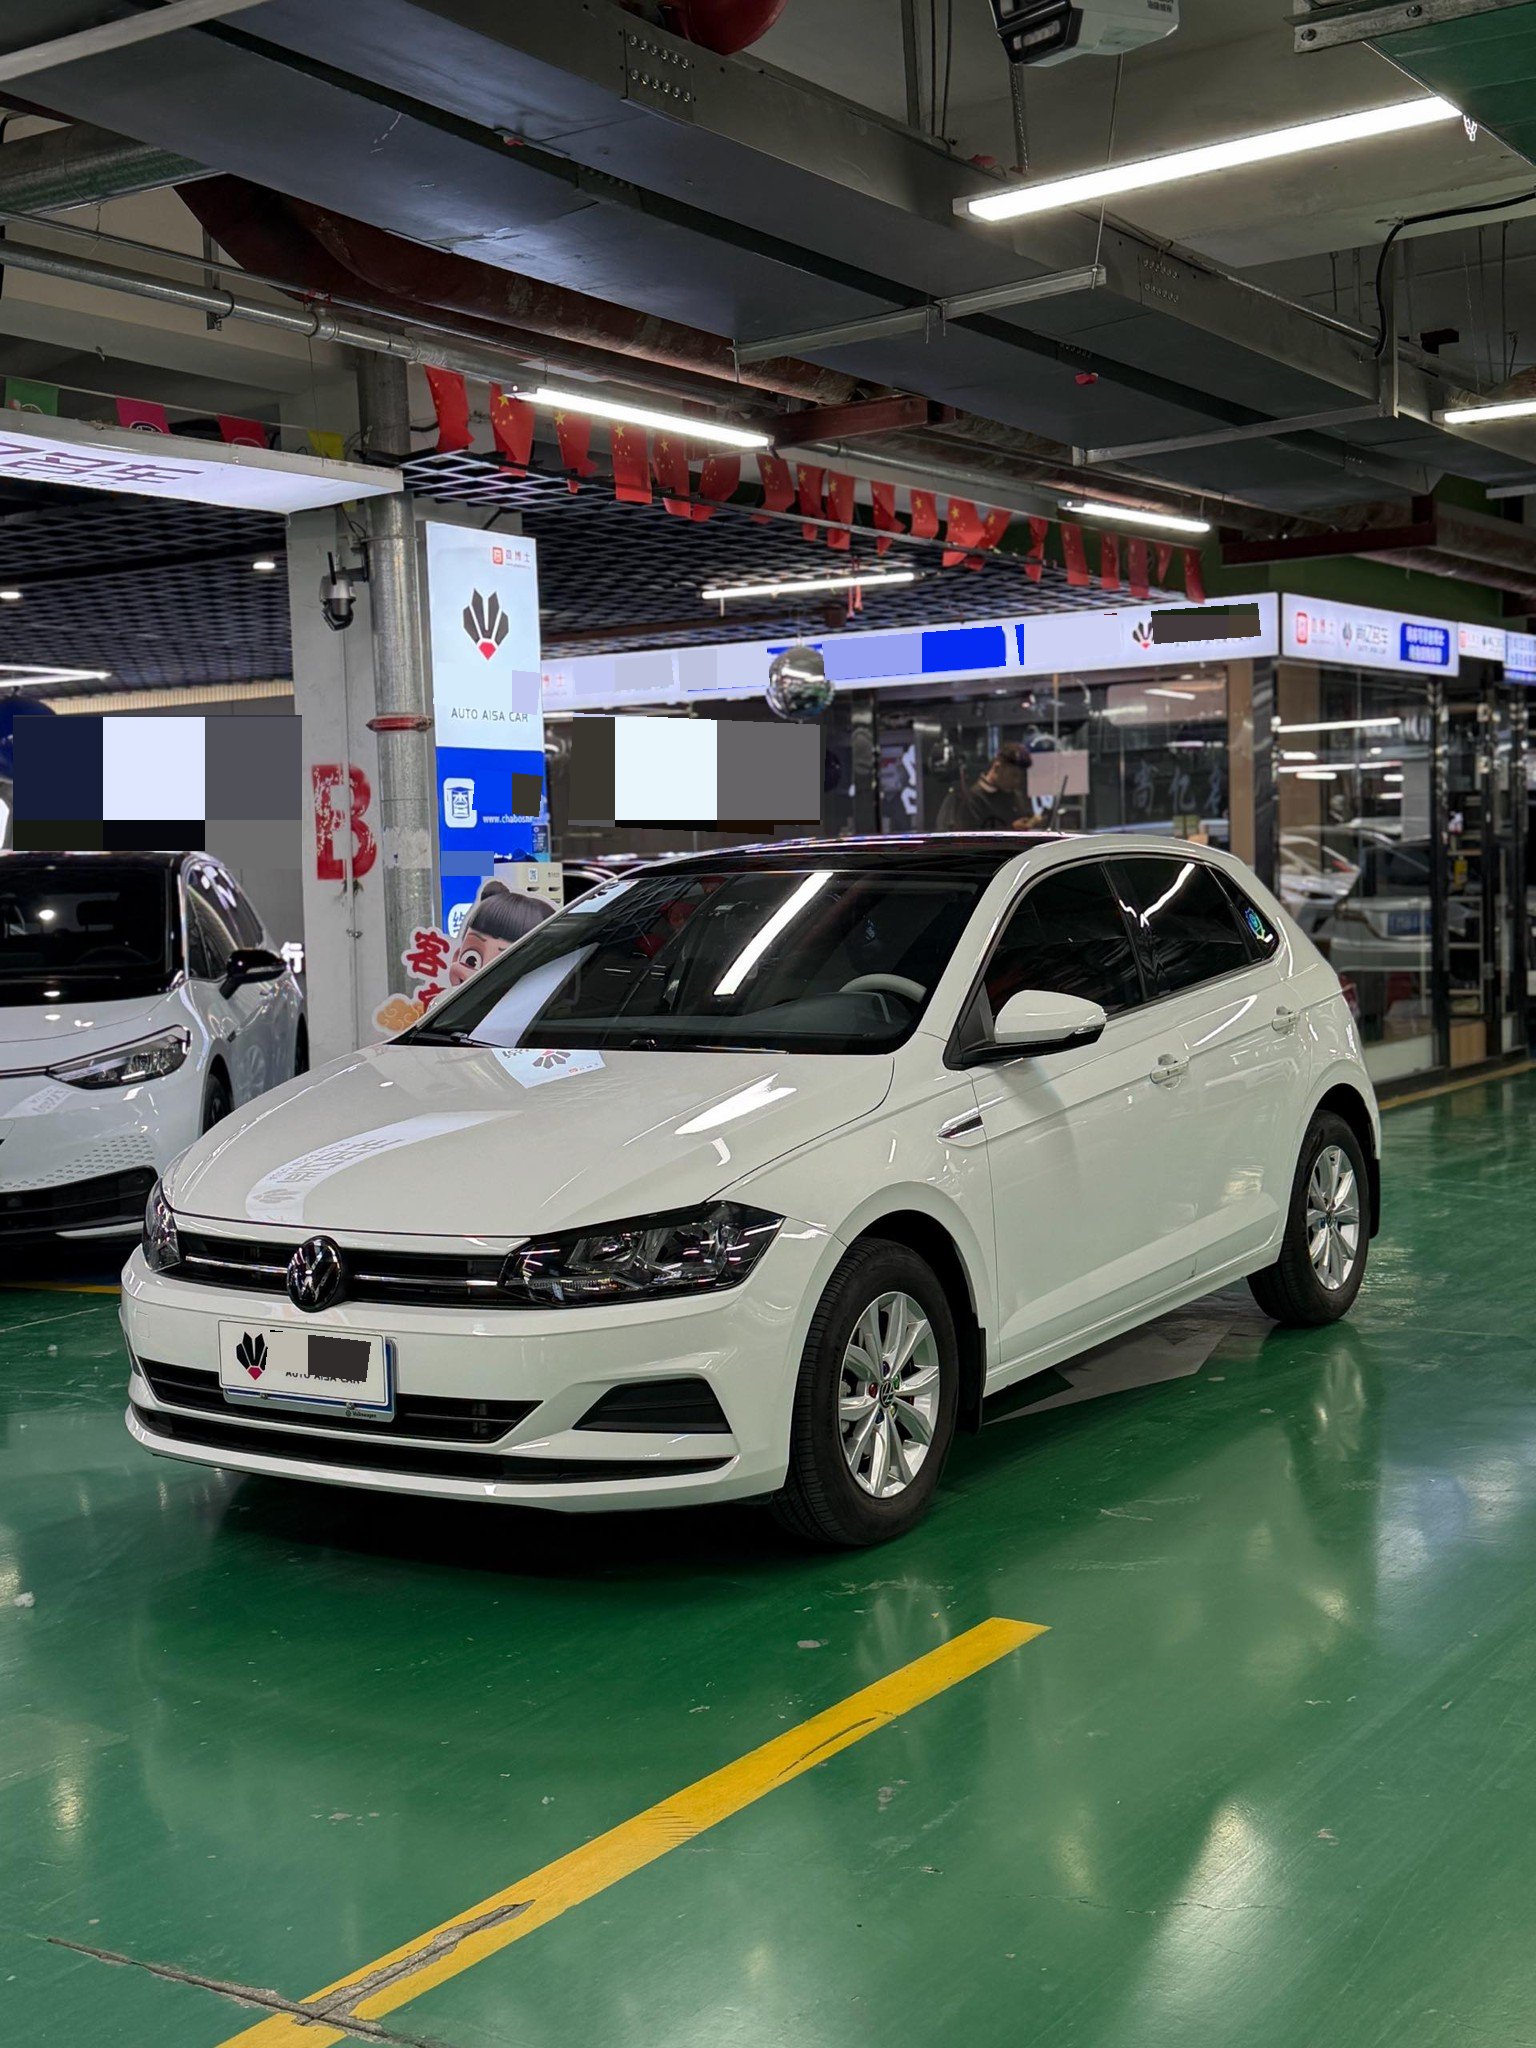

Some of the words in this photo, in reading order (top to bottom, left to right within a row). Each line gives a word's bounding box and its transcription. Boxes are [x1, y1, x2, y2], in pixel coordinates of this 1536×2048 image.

[451, 707, 478, 720] AUTO
[482, 710, 506, 721] AISA
[509, 711, 529, 723] CAR
[311, 763, 377, 881] B
